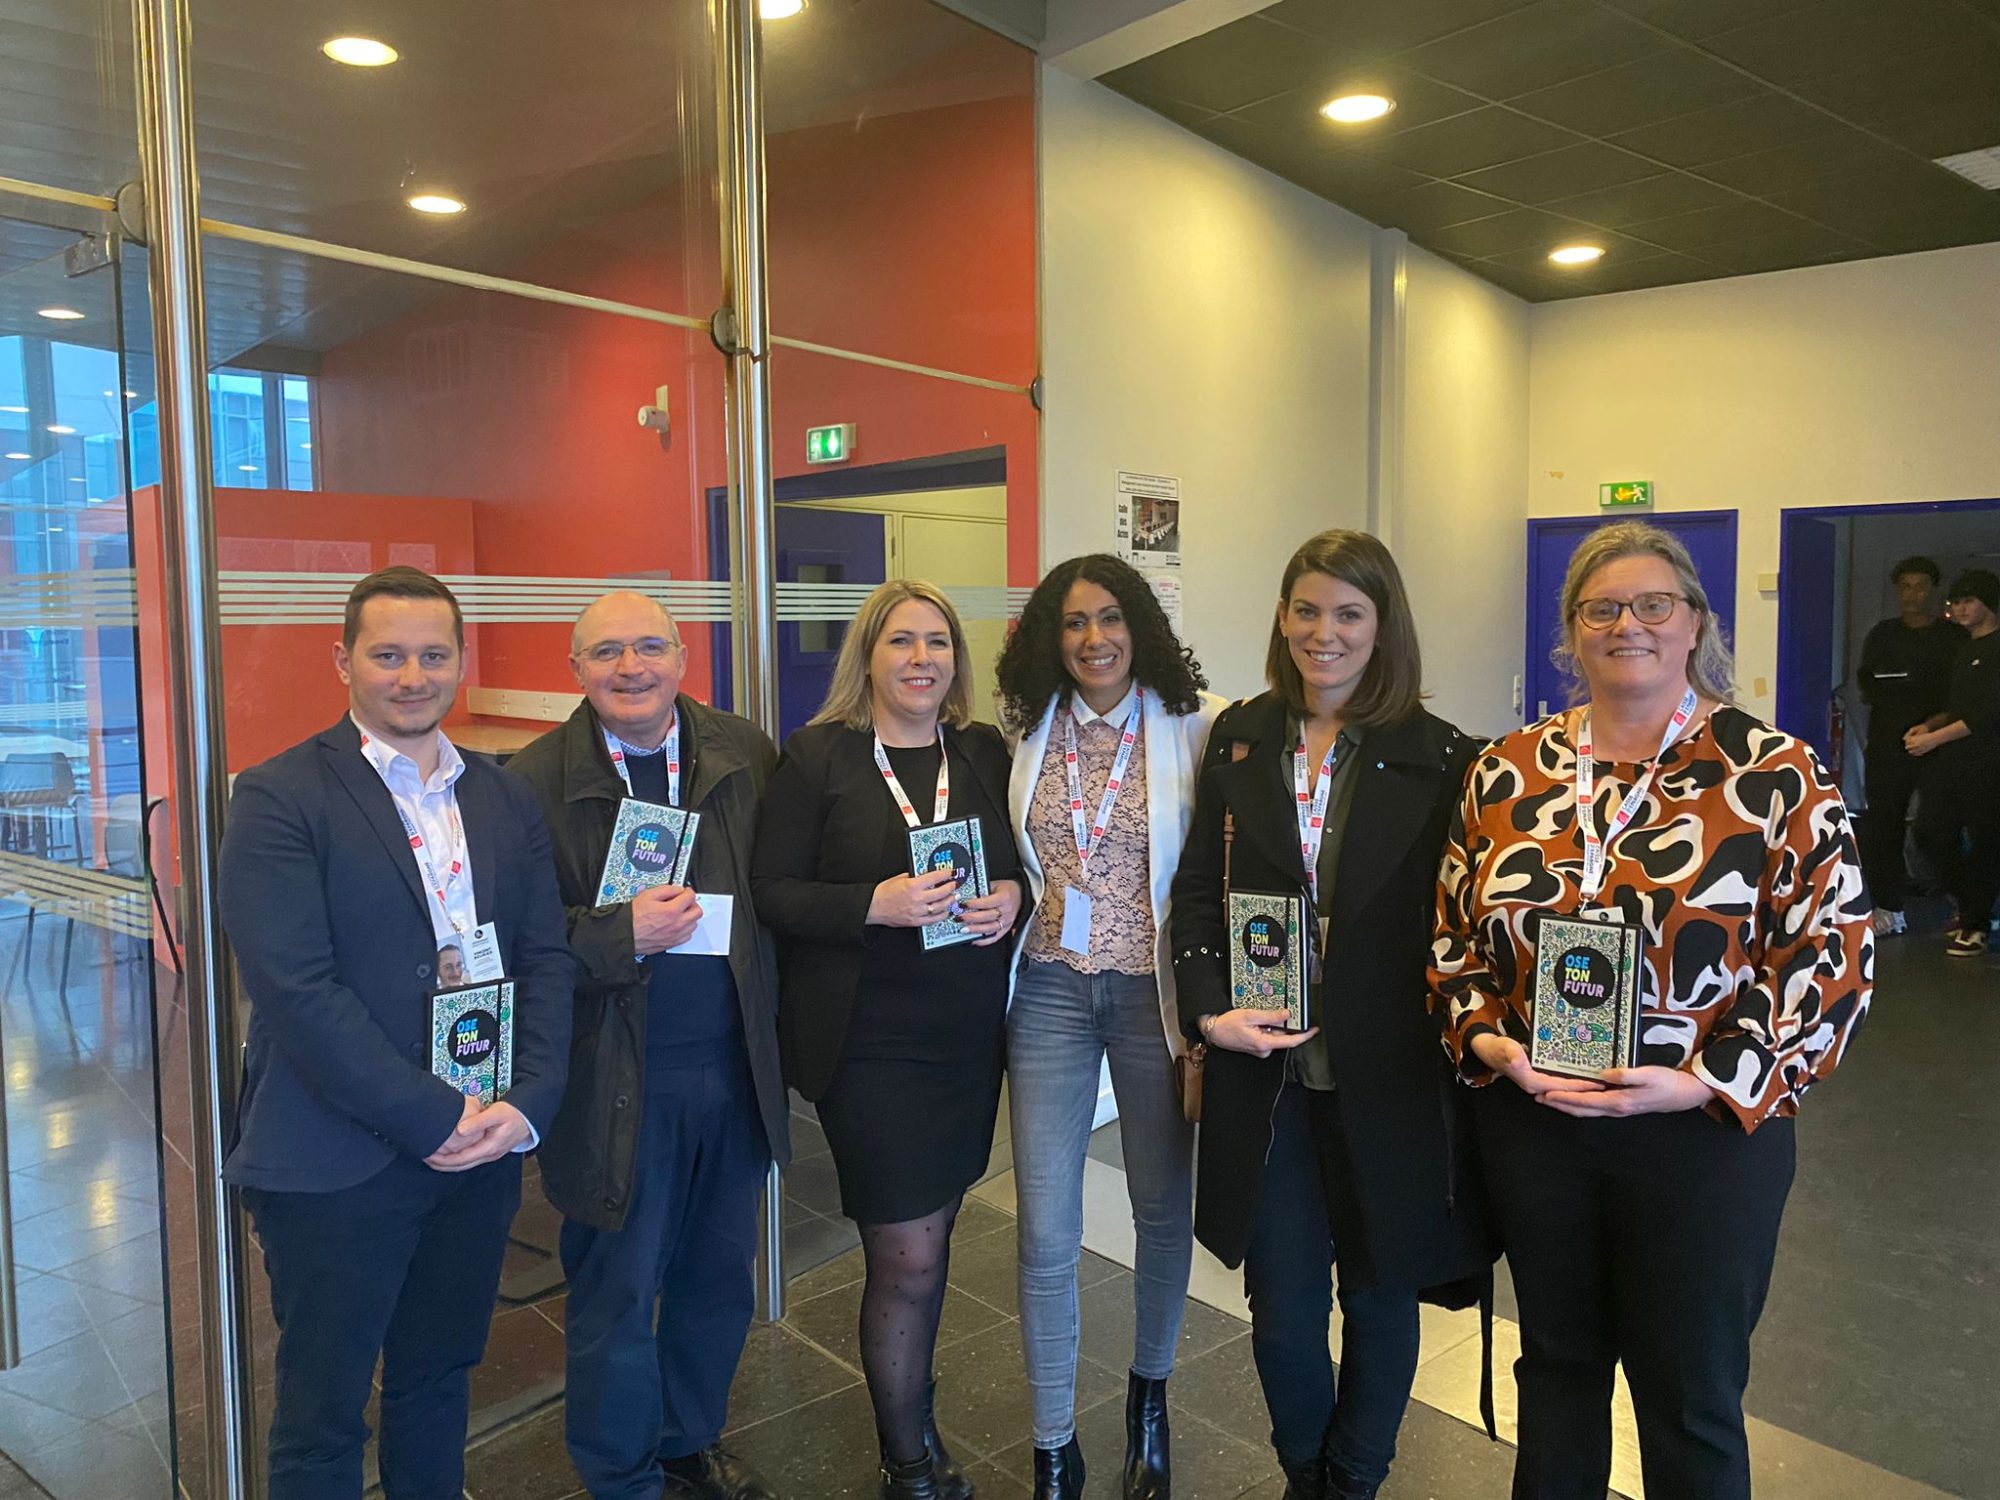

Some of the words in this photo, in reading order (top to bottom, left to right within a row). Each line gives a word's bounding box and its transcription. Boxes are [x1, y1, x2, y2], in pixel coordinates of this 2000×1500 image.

[637, 829, 659, 842] OSE
[635, 839, 657, 851] TON
[632, 849, 666, 864] FUTUR
[934, 850, 952, 862] OSE
[935, 860, 954, 872] TON
[1249, 922, 1268, 935] OSE
[1250, 933, 1269, 945] TON
[1250, 944, 1280, 957] FUTUR
[1565, 954, 1590, 969] OSE
[1565, 968, 1590, 982] TON
[1563, 981, 1604, 998] FUTUR
[457, 1018, 478, 1033] OSE
[456, 1030, 478, 1045] TON
[456, 1039, 490, 1057] FUTUR
